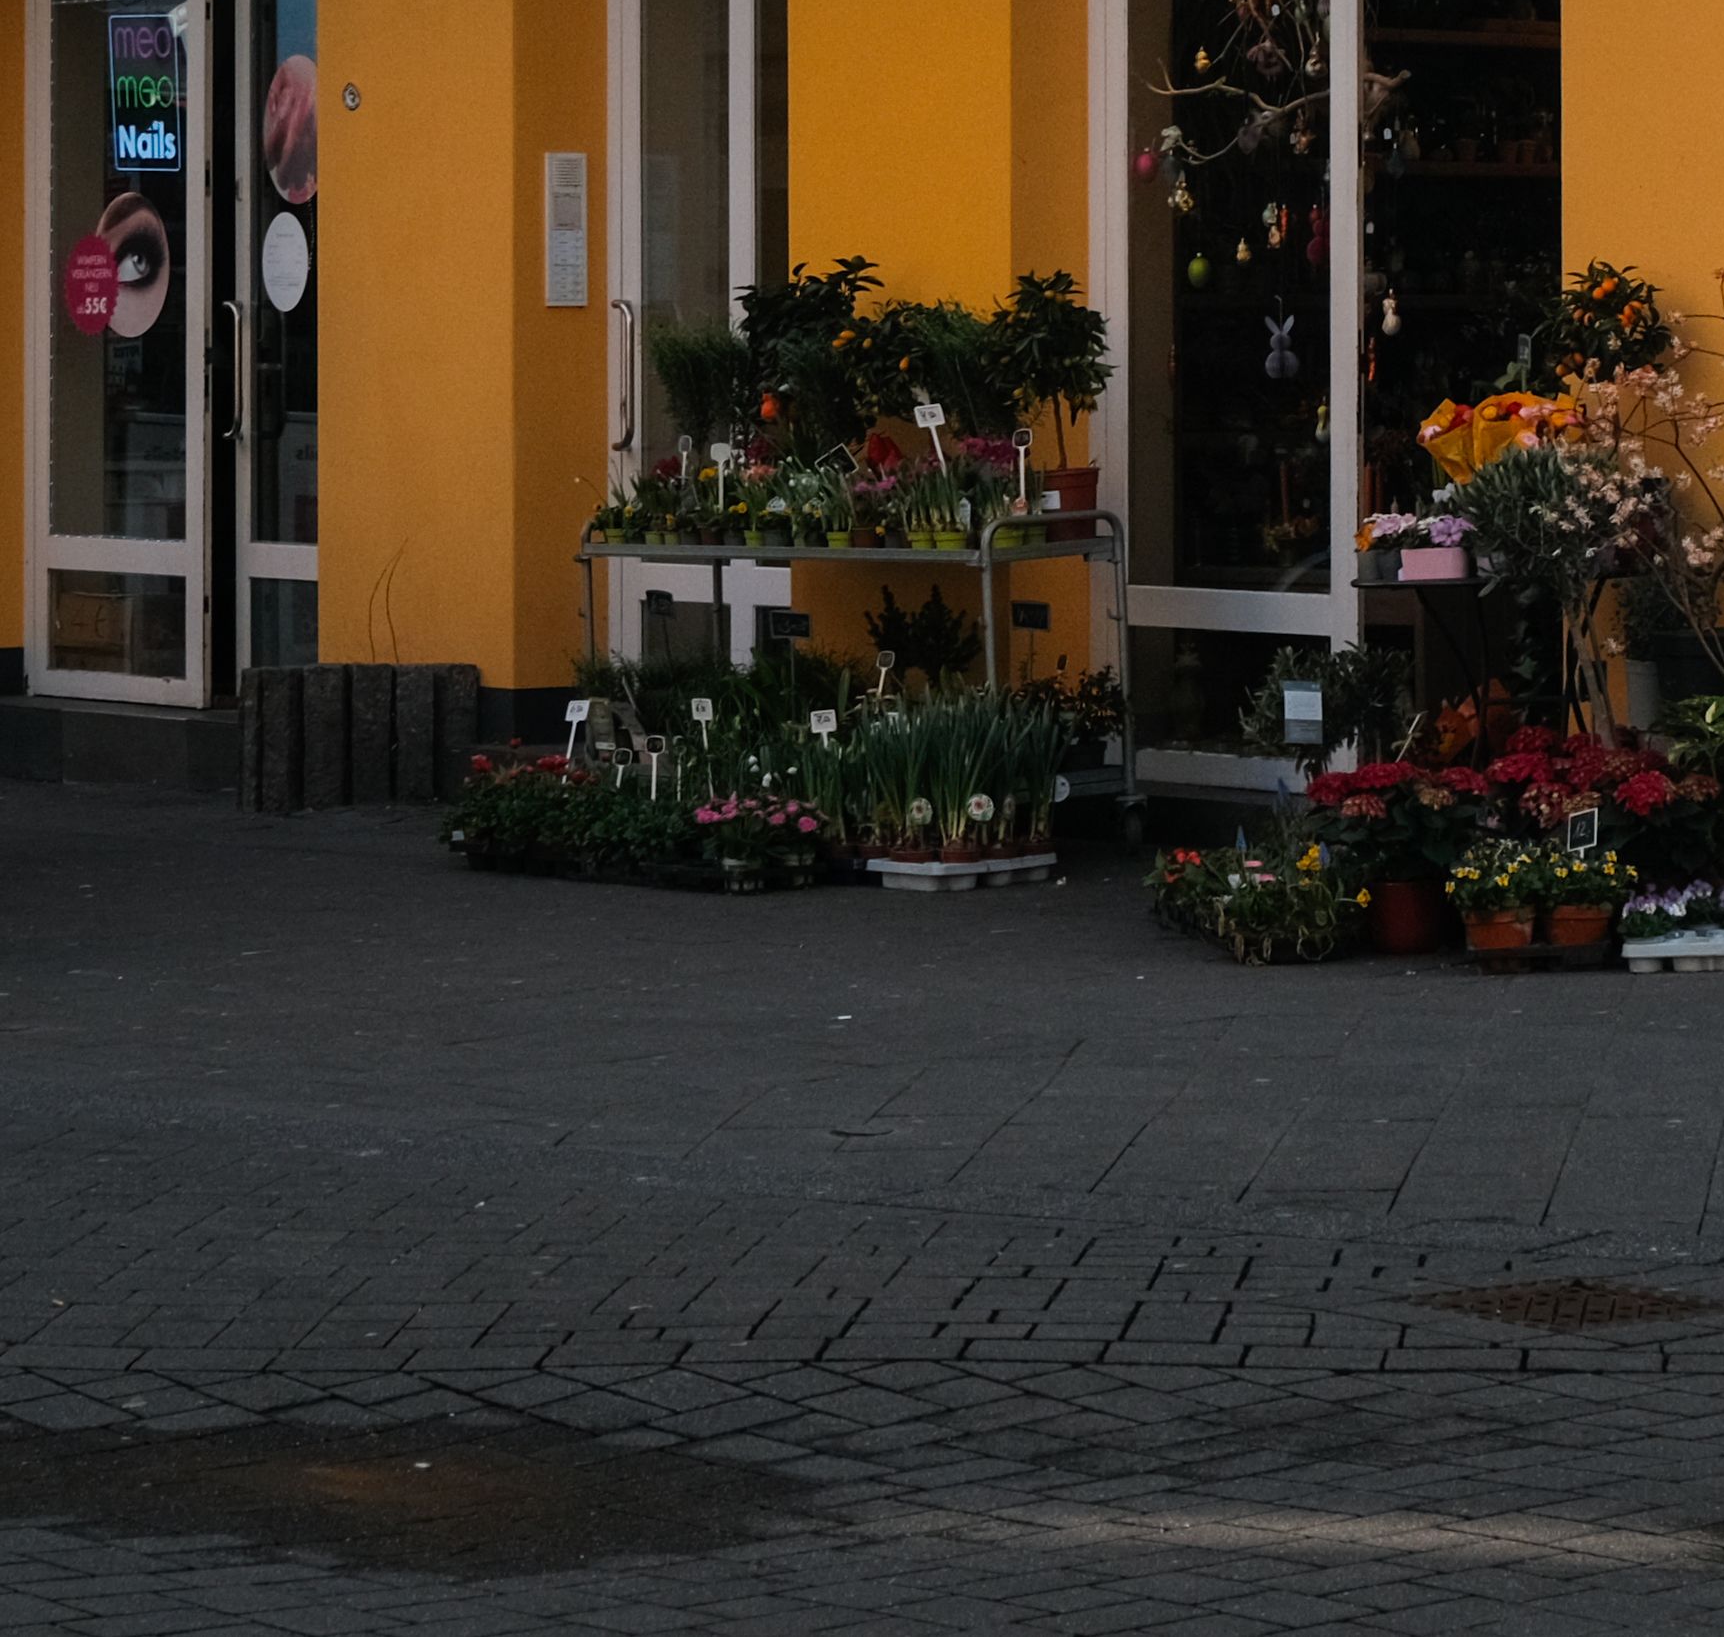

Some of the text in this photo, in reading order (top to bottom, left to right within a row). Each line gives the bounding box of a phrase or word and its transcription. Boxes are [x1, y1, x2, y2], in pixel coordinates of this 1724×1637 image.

[114, 26, 172, 59] meo
[117, 75, 174, 108] meo
[118, 120, 177, 160] Nails
[85, 296, 108, 315] 55€
